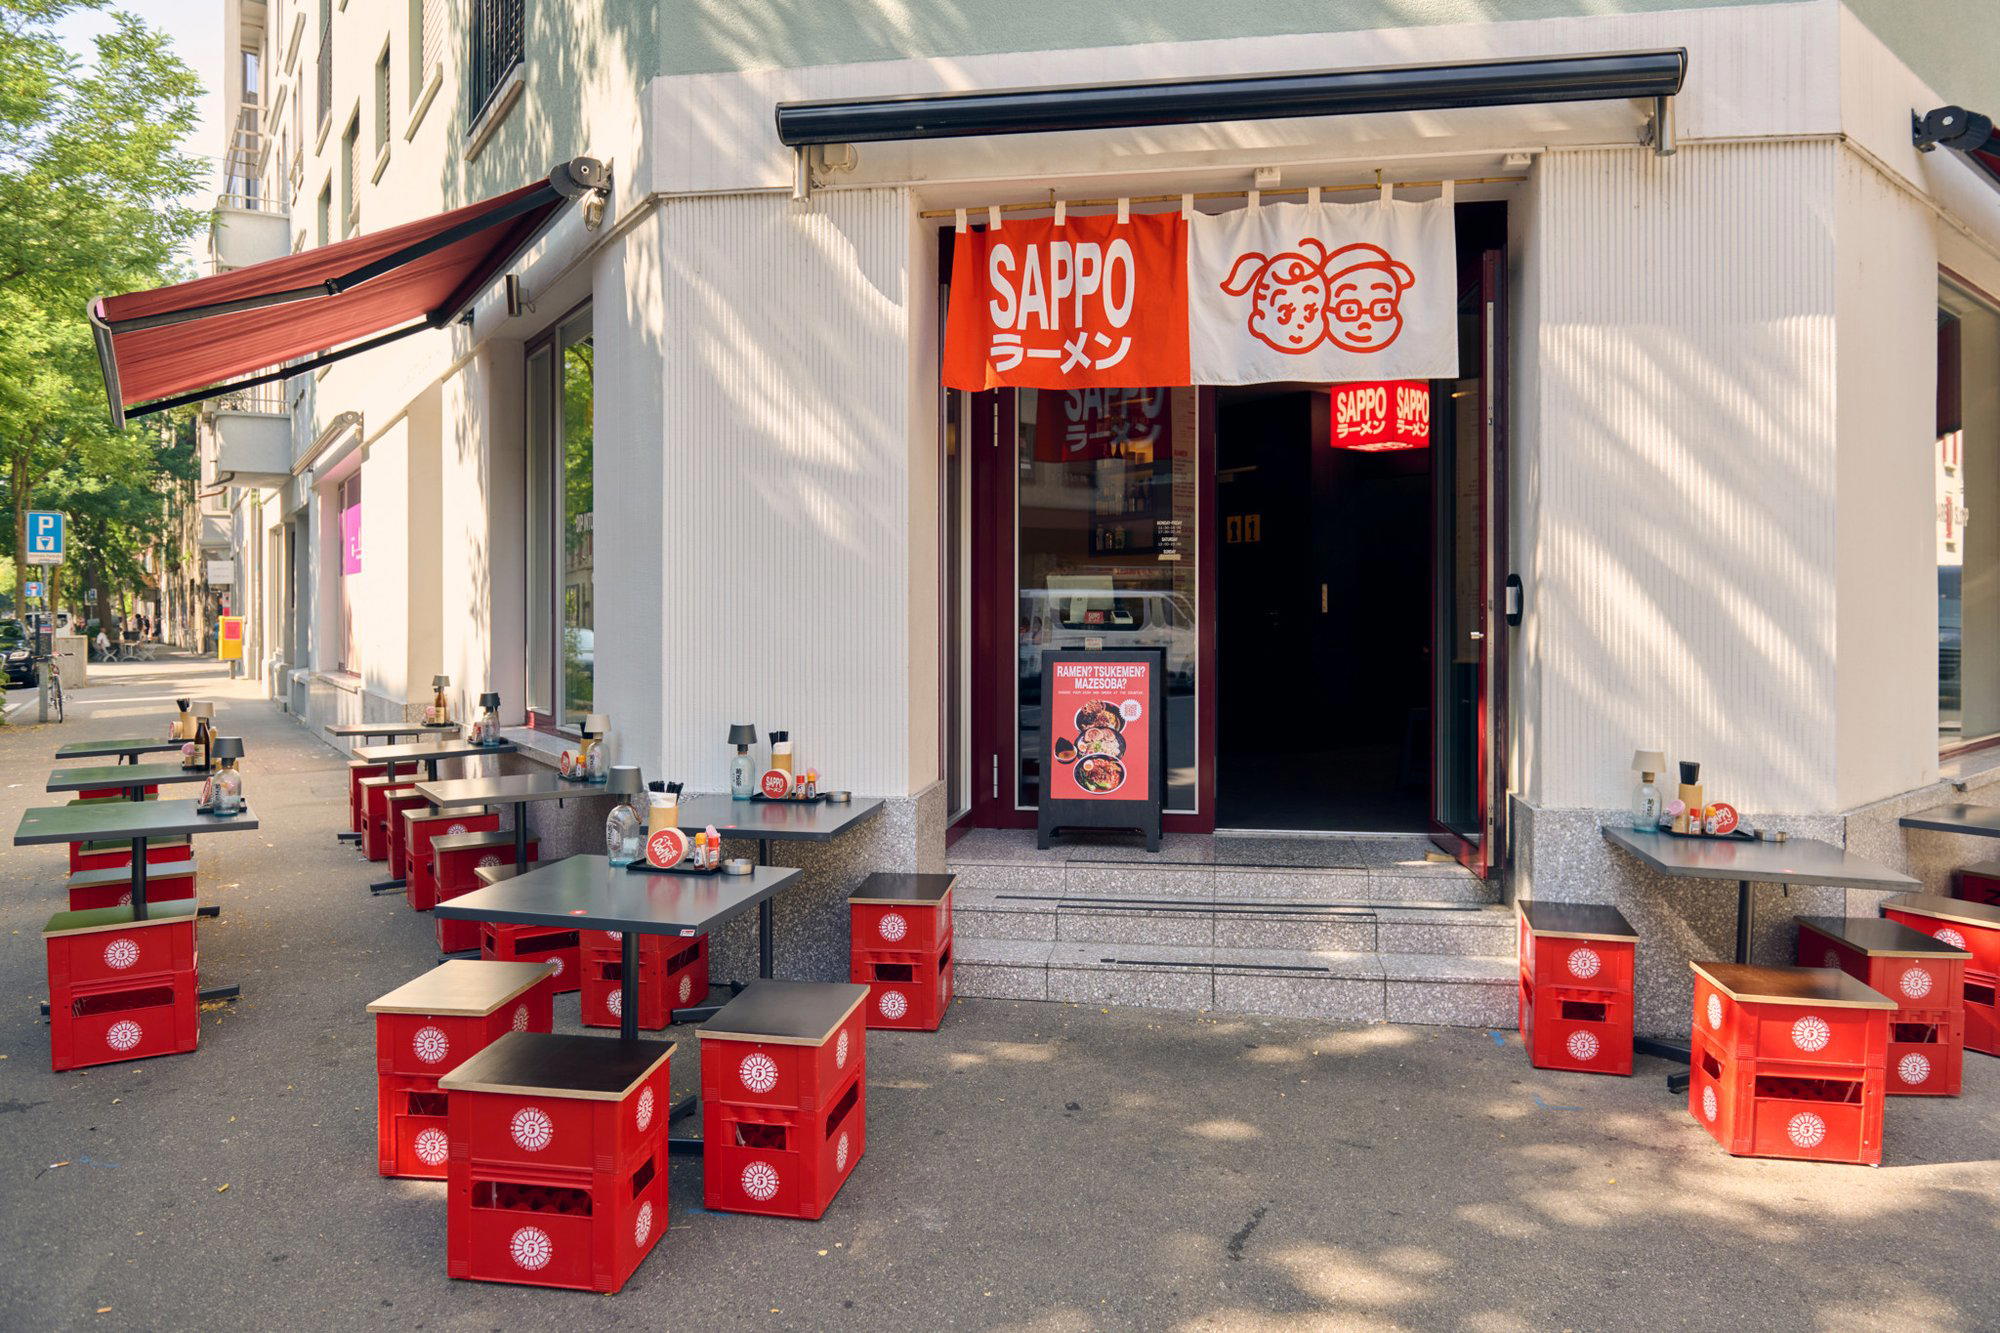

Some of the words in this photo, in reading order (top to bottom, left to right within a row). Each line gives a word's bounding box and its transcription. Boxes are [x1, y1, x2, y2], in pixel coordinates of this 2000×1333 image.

[989, 238, 1135, 330] SAPPO
[990, 331, 1132, 375] ラーメン
[1336, 386, 1387, 423] SAPPO
[1396, 386, 1430, 423] SAPPO
[1336, 420, 1386, 439] ラーメン
[1396, 419, 1430, 437] ラーメン
[38, 516, 54, 535] P
[1057, 666, 1092, 677] RAMEN?
[1093, 665, 1146, 678] TSUKEMEN?
[1074, 677, 1127, 689] MAZESOBA?
[754, 1068, 762, 1078] 5
[527, 1124, 535, 1134] 5
[756, 1176, 764, 1185] 5
[527, 1243, 535, 1253] 5
